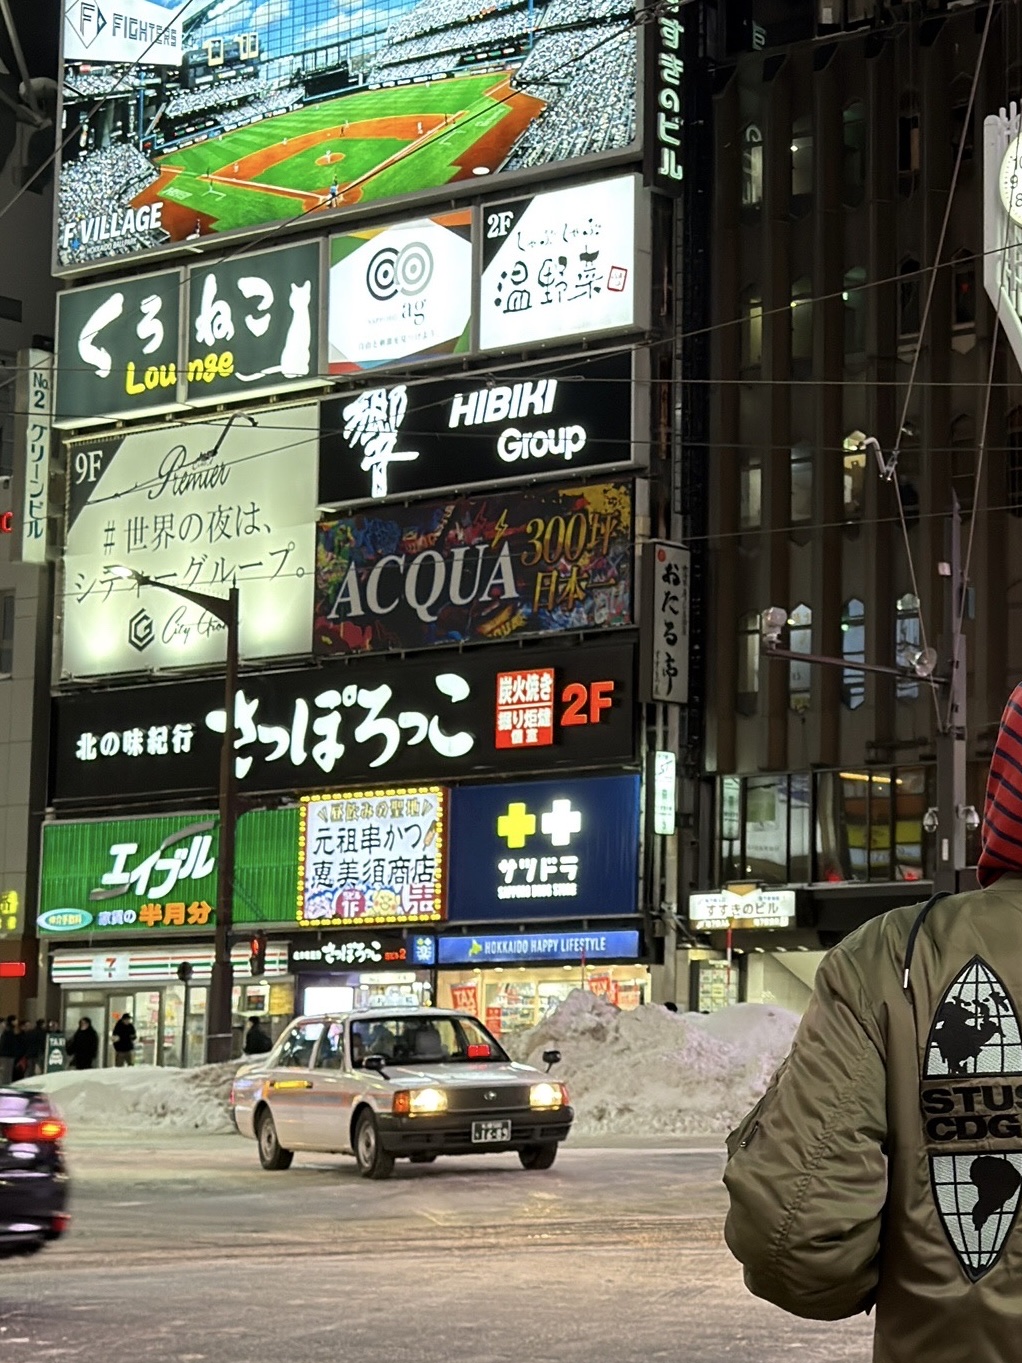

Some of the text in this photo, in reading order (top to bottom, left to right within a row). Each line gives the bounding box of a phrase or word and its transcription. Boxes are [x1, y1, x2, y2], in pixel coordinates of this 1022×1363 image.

[112, 13, 177, 47] FIGHTERS
[81, 202, 163, 244] VILLAGE
[487, 211, 514, 239] 2F
[78, 273, 274, 378] くろねこ
[125, 351, 234, 395] Lounge
[448, 378, 557, 428] HIBIKI
[497, 423, 587, 462] Group
[75, 450, 103, 485] 9F
[327, 541, 520, 624] ACQUA
[499, 672, 553, 704] 炭火焼き
[560, 680, 615, 727] 2F
[76, 724, 194, 761] 北の味紀行
[205, 672, 475, 780] さっぽろっこ
[313, 823, 423, 856] 元祖串かつ
[101, 835, 216, 899] エイブル
[311, 855, 435, 889] 恵美須商店
[497, 855, 579, 884] サツドラ
[707, 903, 779, 917] すすきのビル
[484, 937, 606, 954] HOKKAIDO HAPPY LIFESTYLE
[926, 1114, 1022, 1141] CDG
